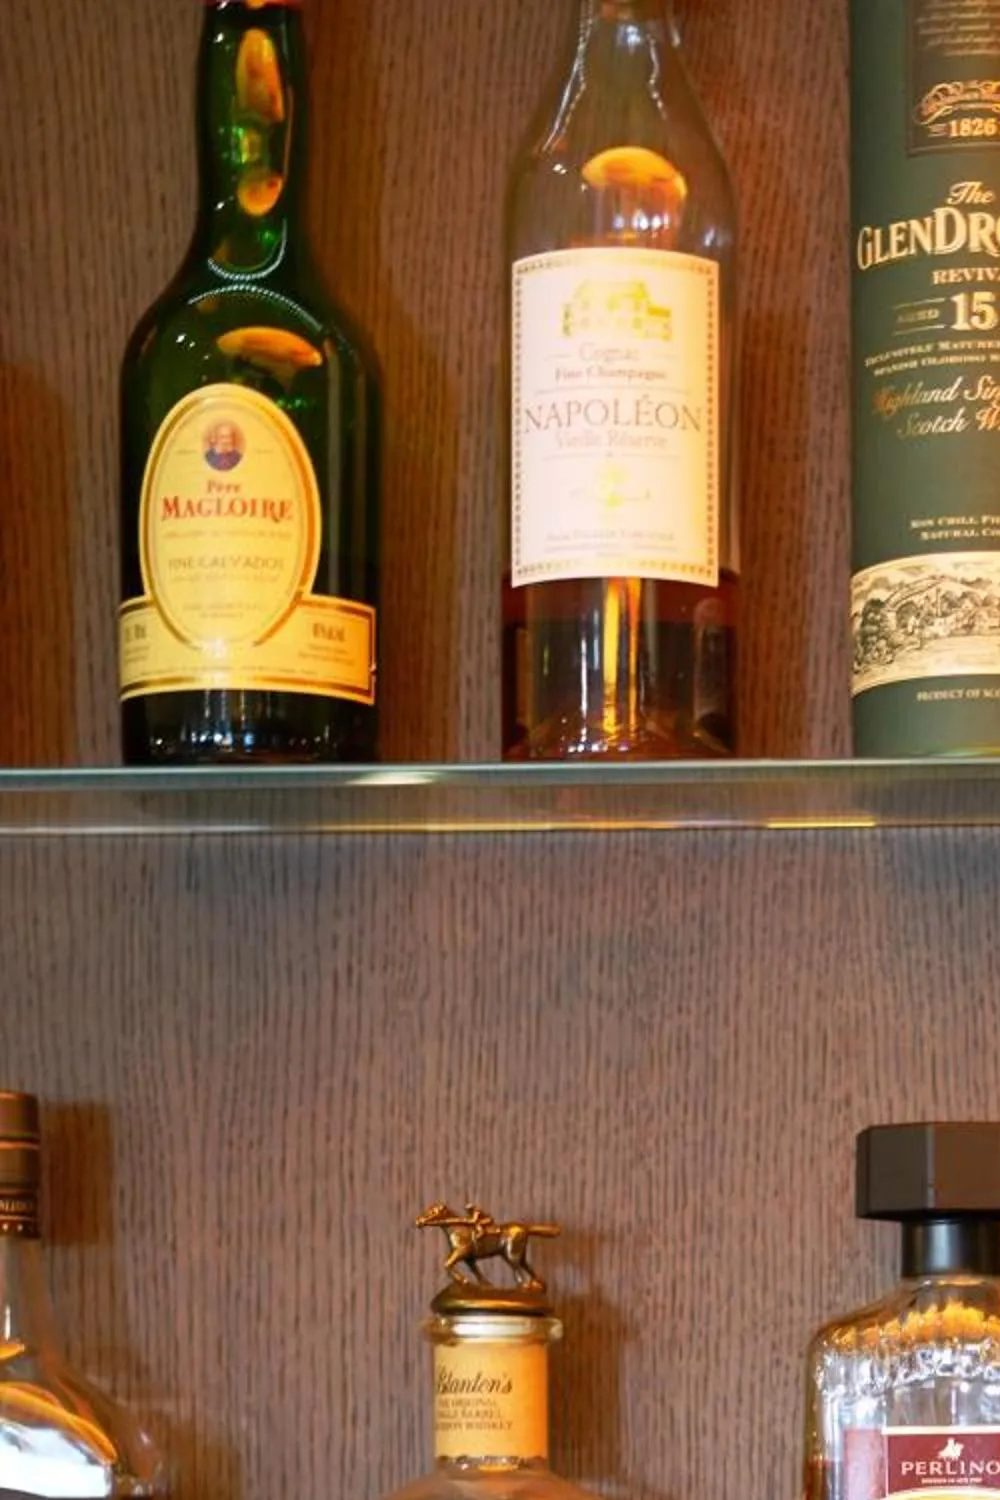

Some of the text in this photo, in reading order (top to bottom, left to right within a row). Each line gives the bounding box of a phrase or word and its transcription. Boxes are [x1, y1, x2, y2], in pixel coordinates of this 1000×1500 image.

[948, 117, 998, 138] 1826
[946, 180, 996, 205] The
[950, 291, 999, 331] 15
[872, 376, 963, 417] Highland
[523, 393, 702, 433] NAPOLÉON
[897, 406, 969, 438] Scotch
[160, 496, 294, 523] MAGLOIRE
